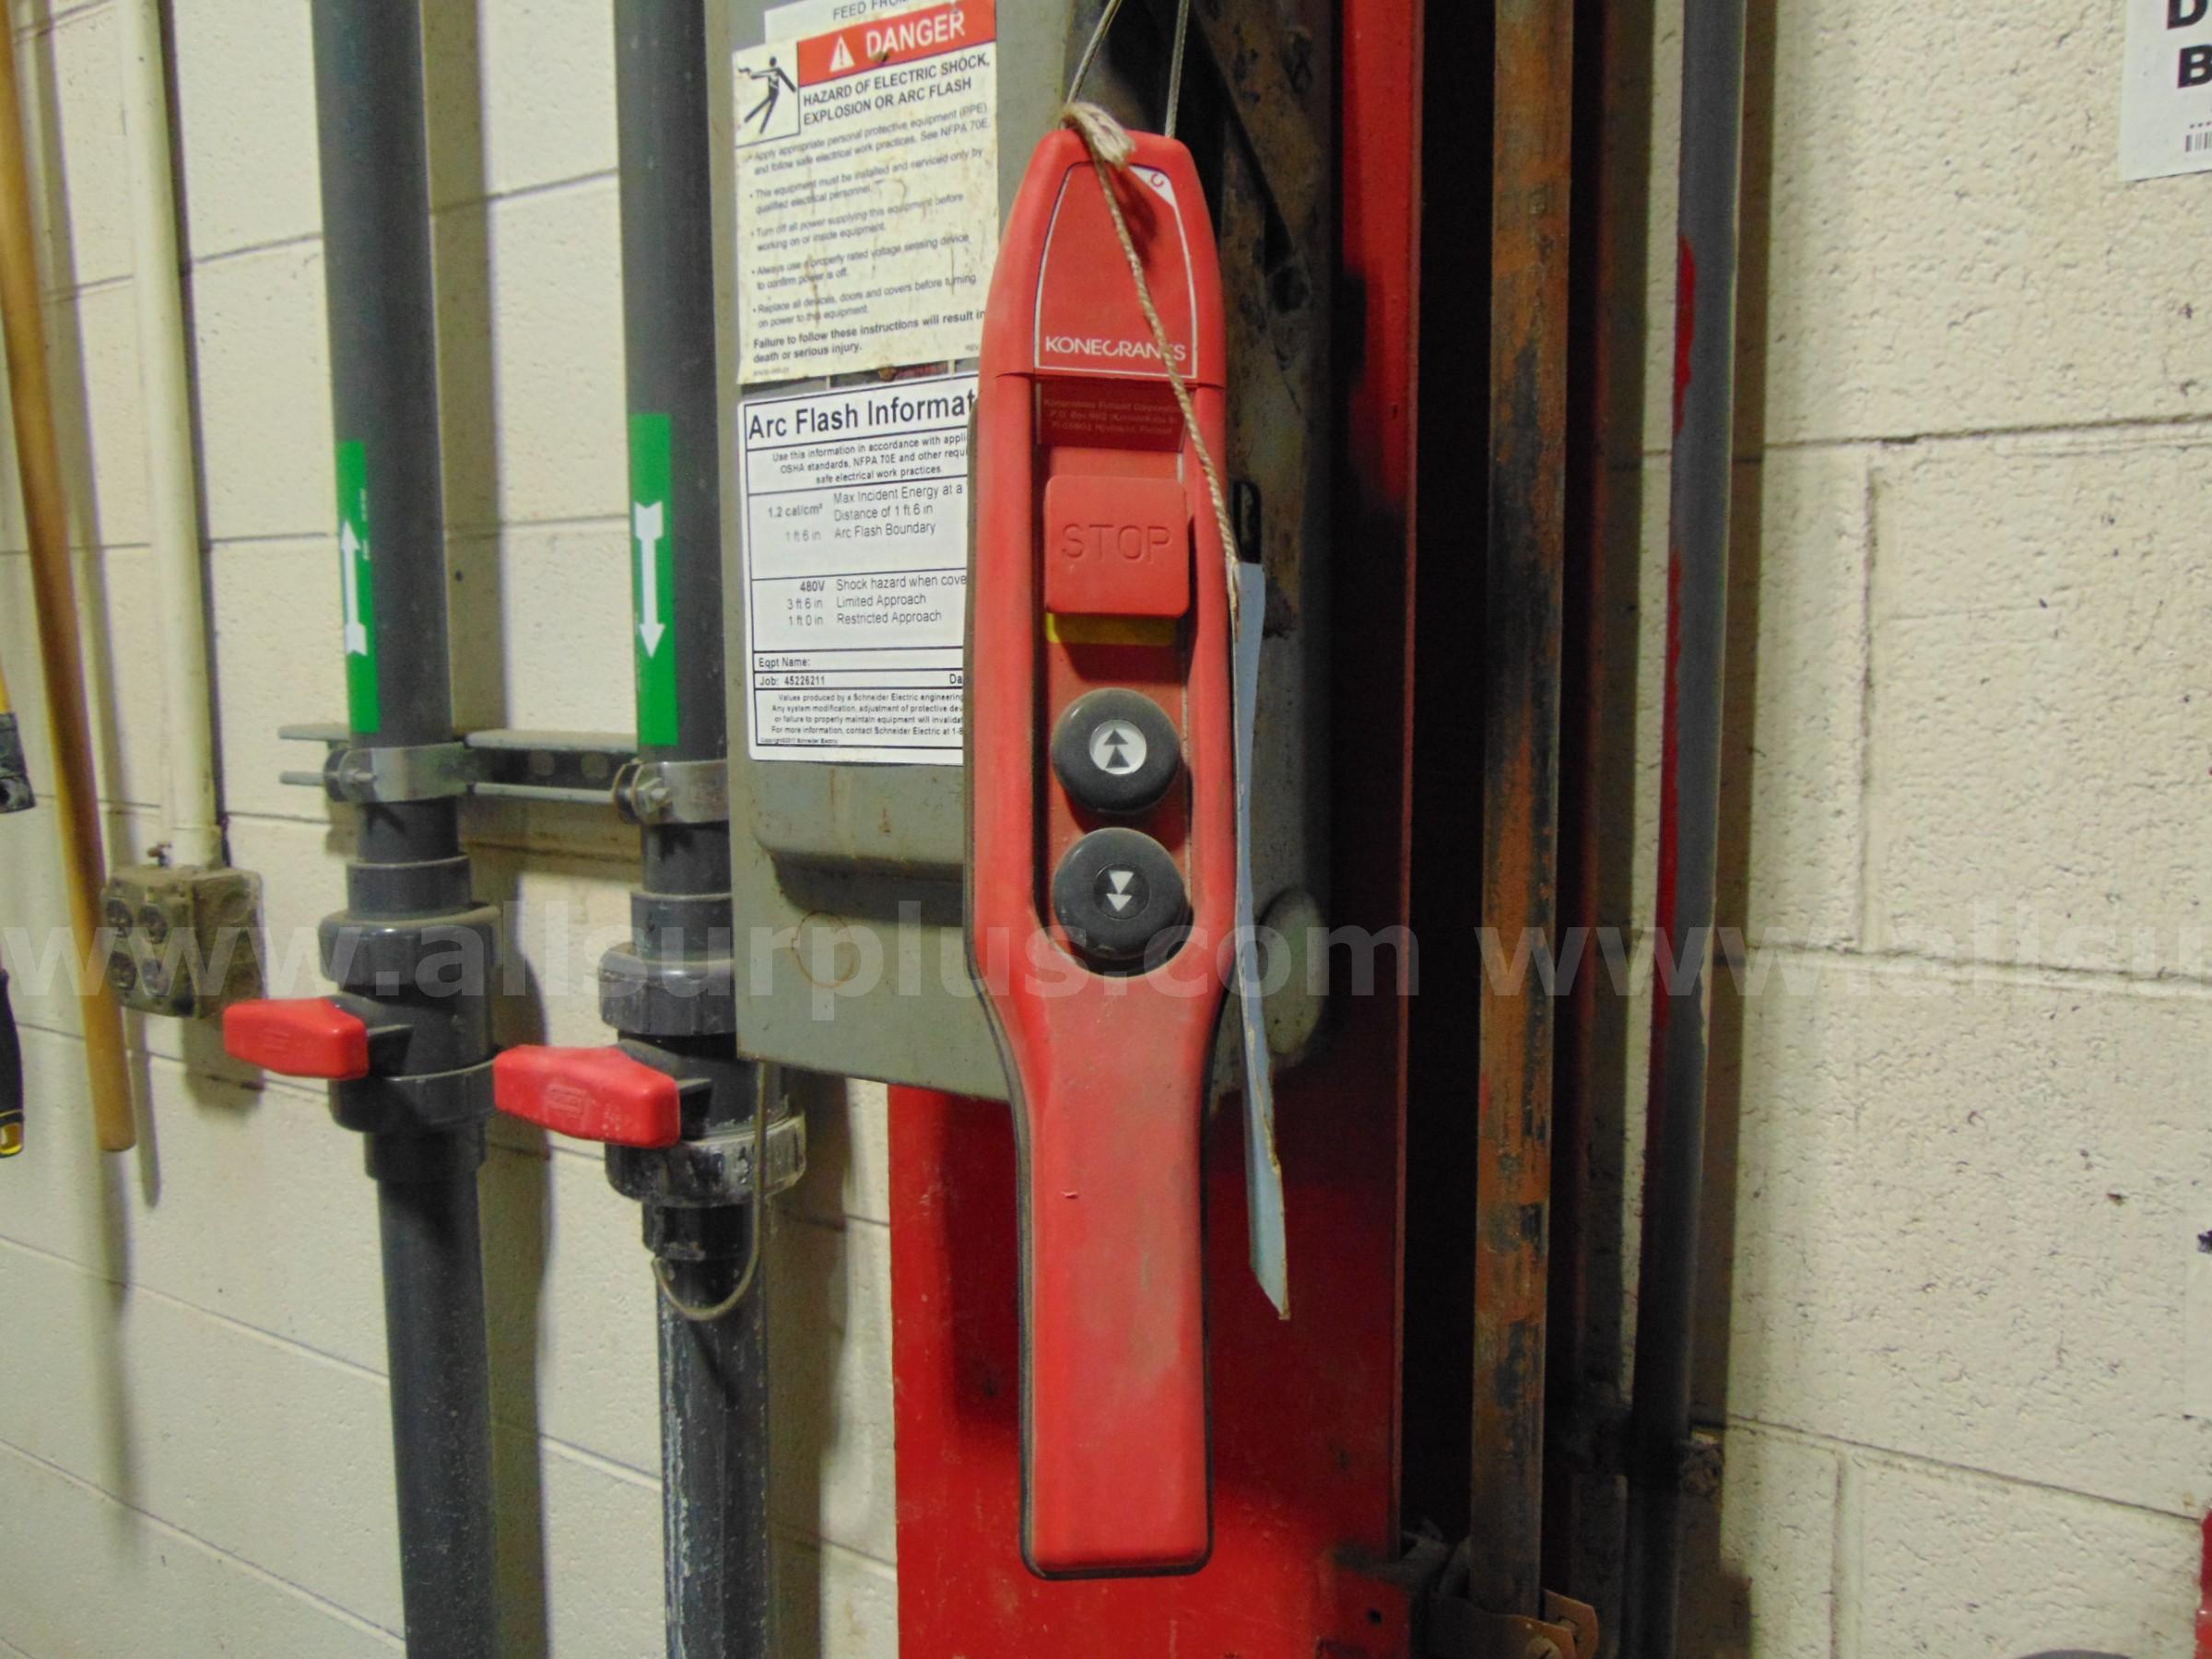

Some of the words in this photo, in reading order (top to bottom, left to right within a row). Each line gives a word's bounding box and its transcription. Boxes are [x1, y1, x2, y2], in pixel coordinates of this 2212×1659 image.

[833, 3, 866, 20] FEED
[866, 11, 965, 60] DANGER
[804, 85, 853, 106] HAZARD
[855, 81, 872, 94] OF
[875, 65, 937, 90] ELECTRIC
[941, 54, 990, 75] SHOCK,
[804, 100, 872, 125] EXPLOSION
[875, 95, 893, 110] OR
[898, 88, 925, 104] ARC
[929, 77, 971, 98] FLASH
[753, 338, 785, 348] Failure
[787, 335, 796, 345] to
[798, 332, 829, 343] follow
[830, 328, 858, 338] these
[860, 320, 919, 335] instructions
[923, 315, 939, 326] will
[943, 311, 973, 324] result
[754, 352, 780, 363] death
[794, 347, 829, 359] serious
[832, 344, 863, 355] injury.
[1045, 335, 1186, 361] KONECRANS
[748, 414, 787, 440] Arc
[796, 403, 859, 434] Flash
[790, 451, 806, 460] this
[808, 446, 855, 458] information
[868, 441, 920, 452] accordance
[922, 437, 941, 446] with
[944, 434, 969, 445] appli
[781, 464, 805, 474] OSHA
[853, 457, 877, 466] NFPA
[880, 455, 896, 465] 70E
[900, 453, 915, 463] and
[918, 452, 942, 461] other
[816, 475, 833, 483] safe
[835, 471, 875, 482] electrical
[877, 469, 897, 478] work
[900, 467, 942, 477] practices
[833, 493, 854, 503] Max
[858, 489, 898, 501] Incident
[901, 488, 938, 499] Energy
[943, 486, 952, 495] at
[834, 510, 878, 522] Distance
[881, 506, 891, 518] of
[924, 504, 934, 514] in
[834, 528, 852, 538] Arc
[854, 525, 883, 537] Flash
[886, 523, 936, 535] Boundary
[1062, 523, 1173, 565] STOP
[800, 581, 826, 592] 480V
[836, 579, 867, 591] Shock
[871, 577, 907, 589] hazard
[909, 576, 938, 587] when
[815, 597, 823, 608] in
[837, 595, 874, 608] Limited
[877, 594, 927, 608] Approach
[838, 612, 888, 624] Restricted
[891, 610, 942, 625] Approach
[759, 658, 780, 669] Eqpt
[782, 657, 811, 666] Name:
[759, 677, 779, 686] Job:
